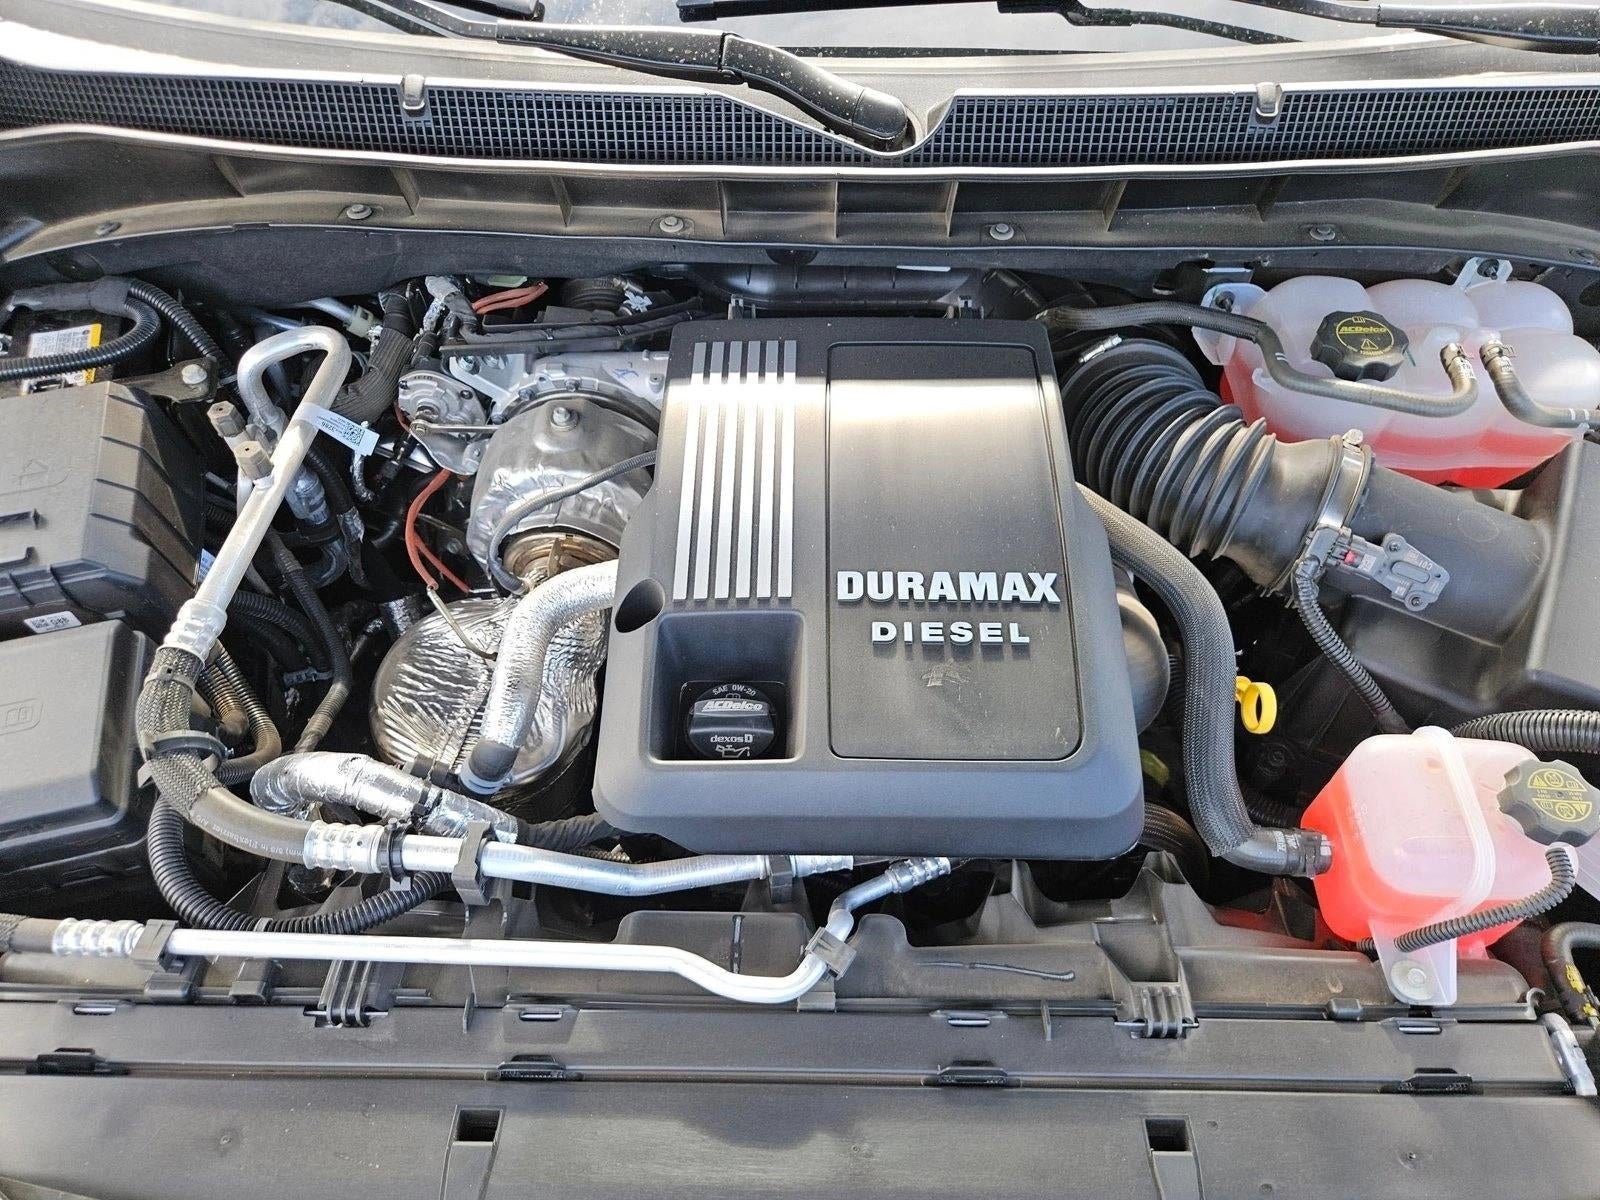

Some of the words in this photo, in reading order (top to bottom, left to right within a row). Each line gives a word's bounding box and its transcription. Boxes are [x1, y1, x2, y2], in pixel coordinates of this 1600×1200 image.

[1338, 326, 1387, 334] ACDelco
[837, 571, 1060, 603] DURAMAX
[872, 621, 1029, 645] DIESEL
[712, 686, 728, 695] SAE
[732, 684, 757, 696] 0W-20
[701, 700, 763, 712] ACDelco
